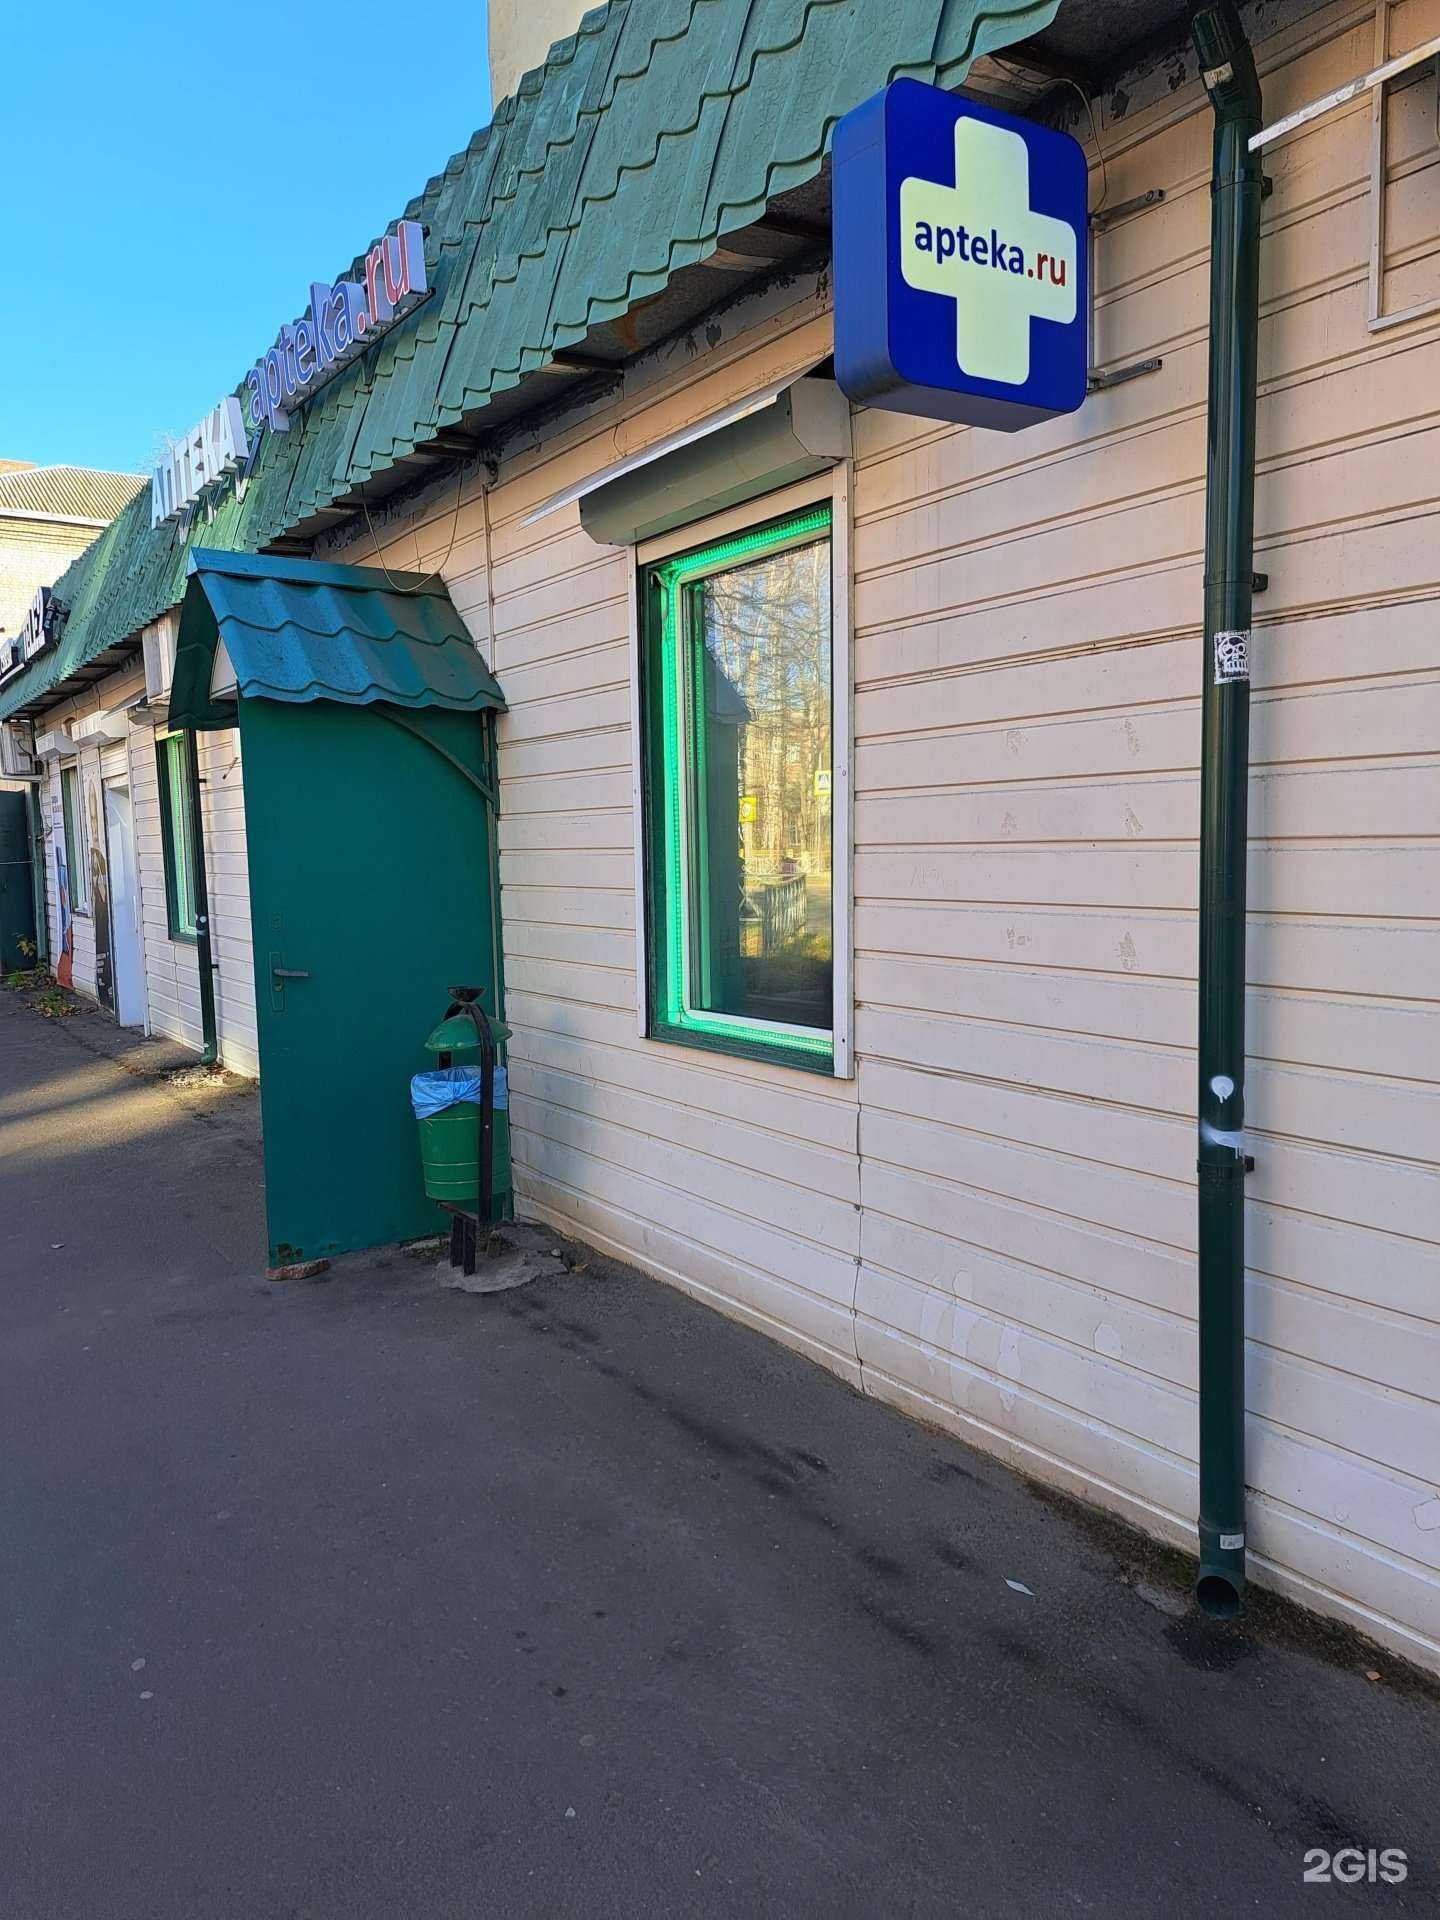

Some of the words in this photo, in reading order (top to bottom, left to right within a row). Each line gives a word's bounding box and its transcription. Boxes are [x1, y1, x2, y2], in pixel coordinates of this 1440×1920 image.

[914, 221, 1066, 287] apteka.ru
[248, 220, 418, 433] apteka.ru
[151, 396, 246, 530] АПТЕКА
